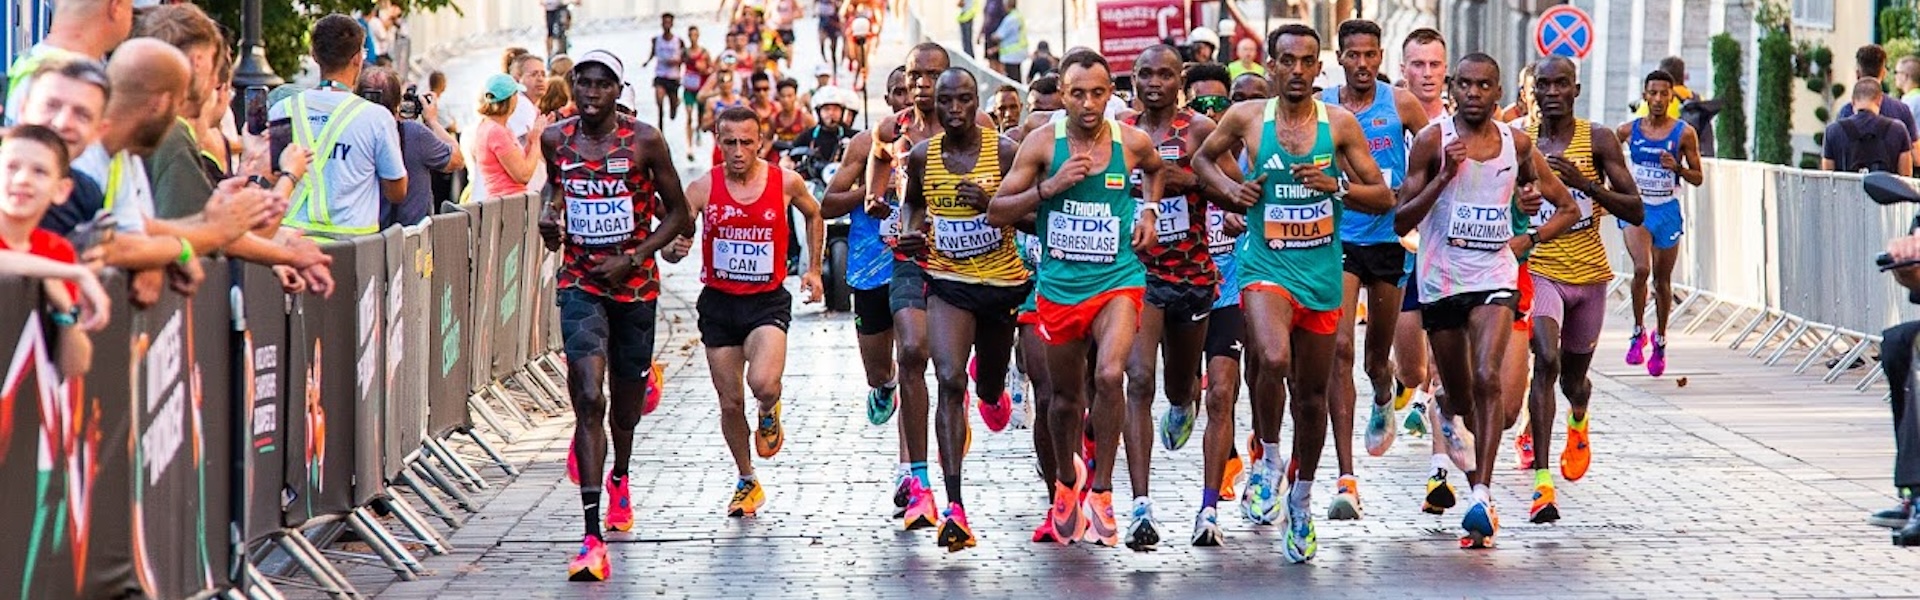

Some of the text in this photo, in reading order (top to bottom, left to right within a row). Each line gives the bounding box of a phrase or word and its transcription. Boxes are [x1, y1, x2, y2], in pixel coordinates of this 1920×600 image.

[1645, 169, 1671, 179] TDK
[561, 179, 629, 195] KENYA
[580, 201, 626, 215] TDK
[1062, 199, 1112, 217] ETHIOPIA
[1284, 203, 1327, 220] TDK
[1472, 206, 1508, 221] TDK
[571, 216, 630, 233] KIPLAGAT
[947, 216, 988, 232] TDK
[1067, 218, 1114, 233] TDK
[1281, 222, 1320, 237] TOLA
[718, 225, 773, 240] TÜRKİYE
[729, 243, 769, 256] TDK
[1050, 232, 1116, 252] GEBRESILASE
[729, 257, 757, 271] CAN
